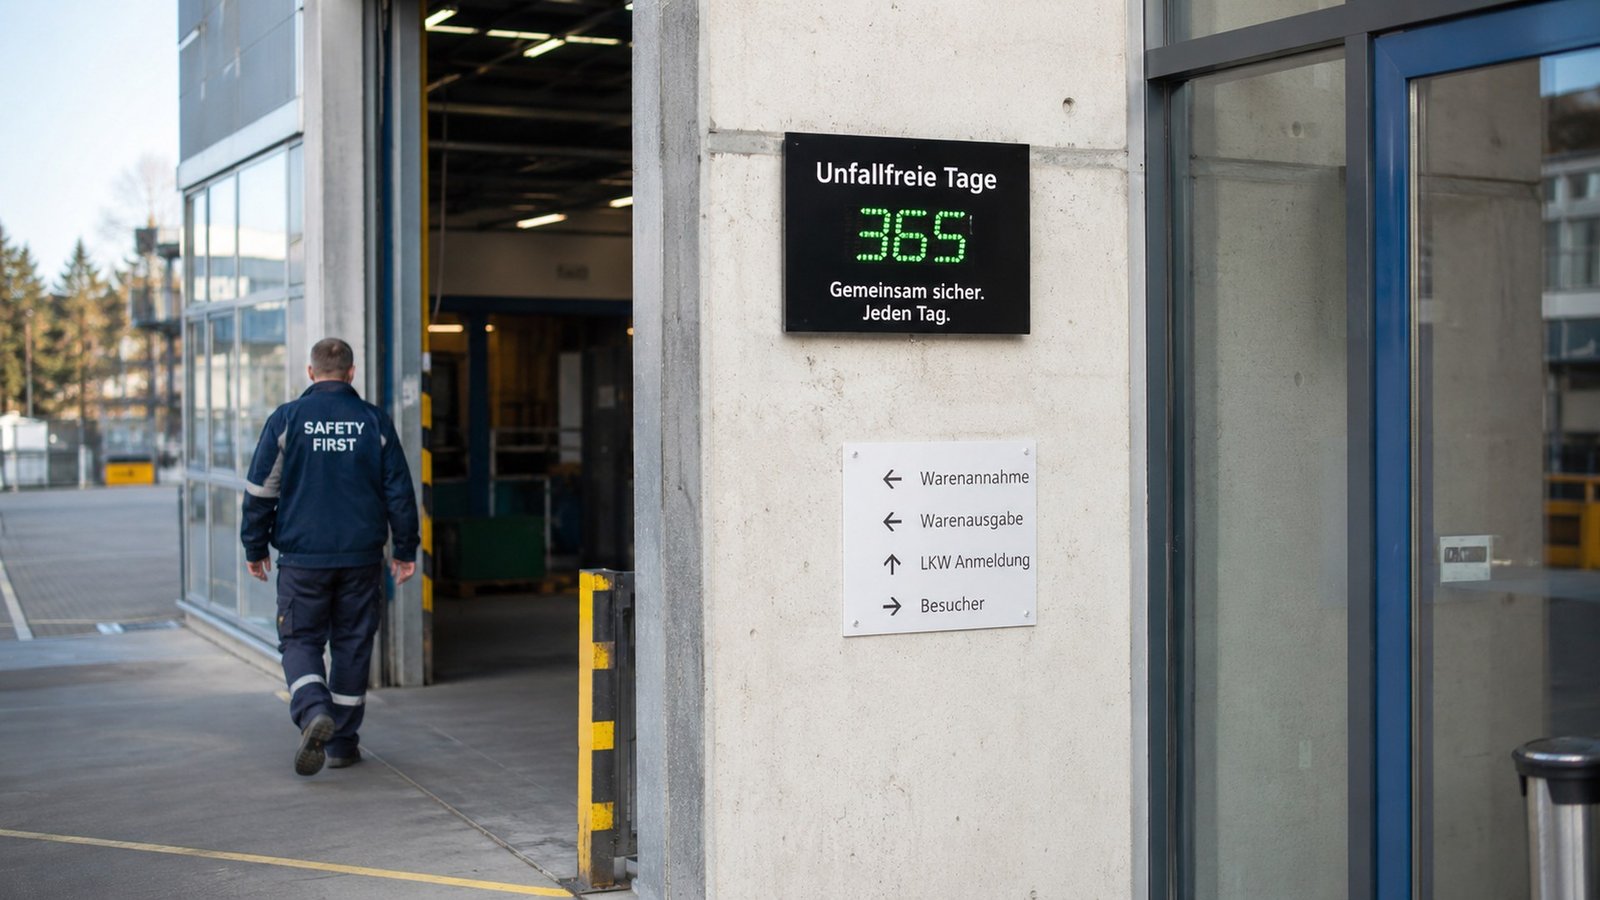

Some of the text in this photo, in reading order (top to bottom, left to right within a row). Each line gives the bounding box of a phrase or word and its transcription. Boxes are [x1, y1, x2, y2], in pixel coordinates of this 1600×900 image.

[816, 161, 997, 194] Unfallfreie Tage
[856, 207, 966, 263] 365
[829, 280, 985, 300] Gemeinsam sicher.
[862, 304, 951, 325] Jeden Tag.
[303, 420, 365, 452] SAFETY FIRST
[920, 468, 1030, 486] Warenannahme
[920, 510, 1024, 530] Warenausgabe
[920, 552, 1031, 571] LKW Anmeldung
[920, 595, 985, 613] Besucher
